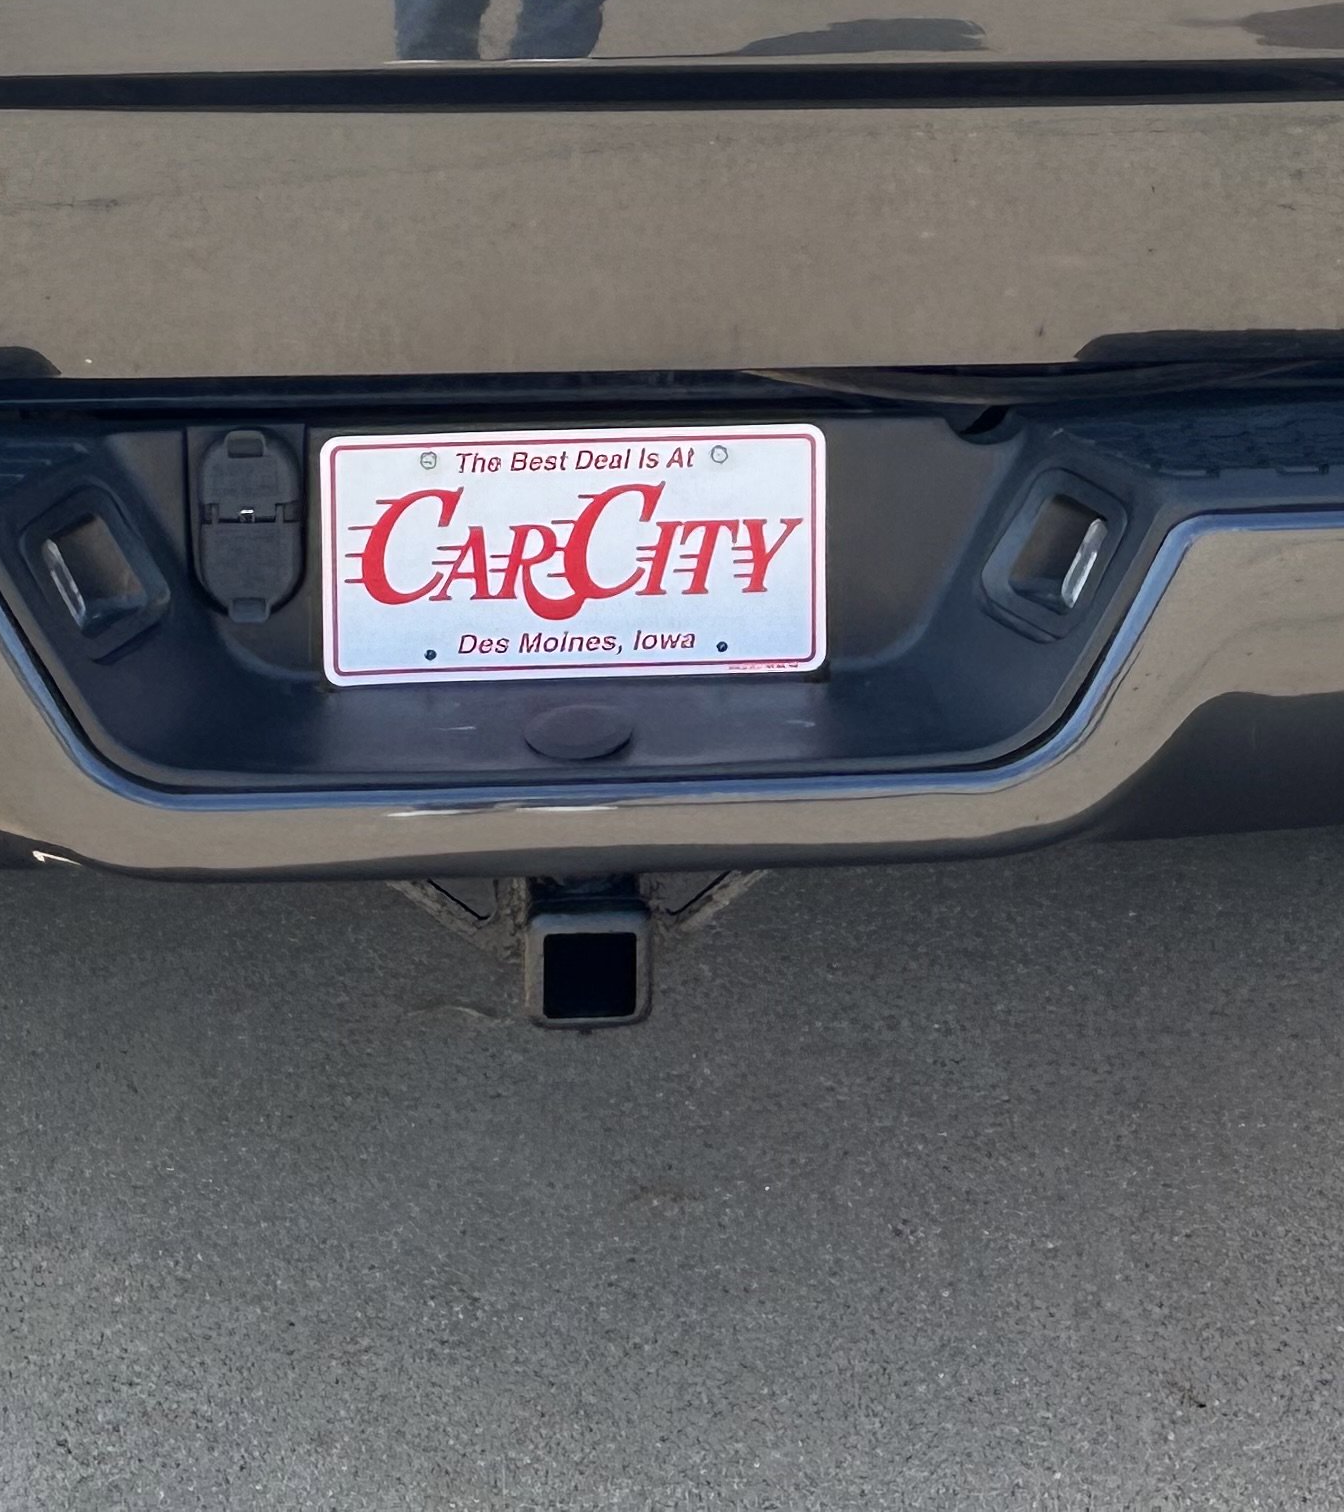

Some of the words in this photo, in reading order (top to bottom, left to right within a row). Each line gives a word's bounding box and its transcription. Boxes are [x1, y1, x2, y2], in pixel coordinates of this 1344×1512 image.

[456, 452, 501, 474] The
[510, 450, 568, 472] Best
[575, 448, 631, 470] Deal
[639, 447, 659, 469] Is
[666, 446, 695, 468] At
[458, 634, 509, 654] Des
[519, 631, 623, 655] Moines,
[633, 630, 696, 650] Iowa
